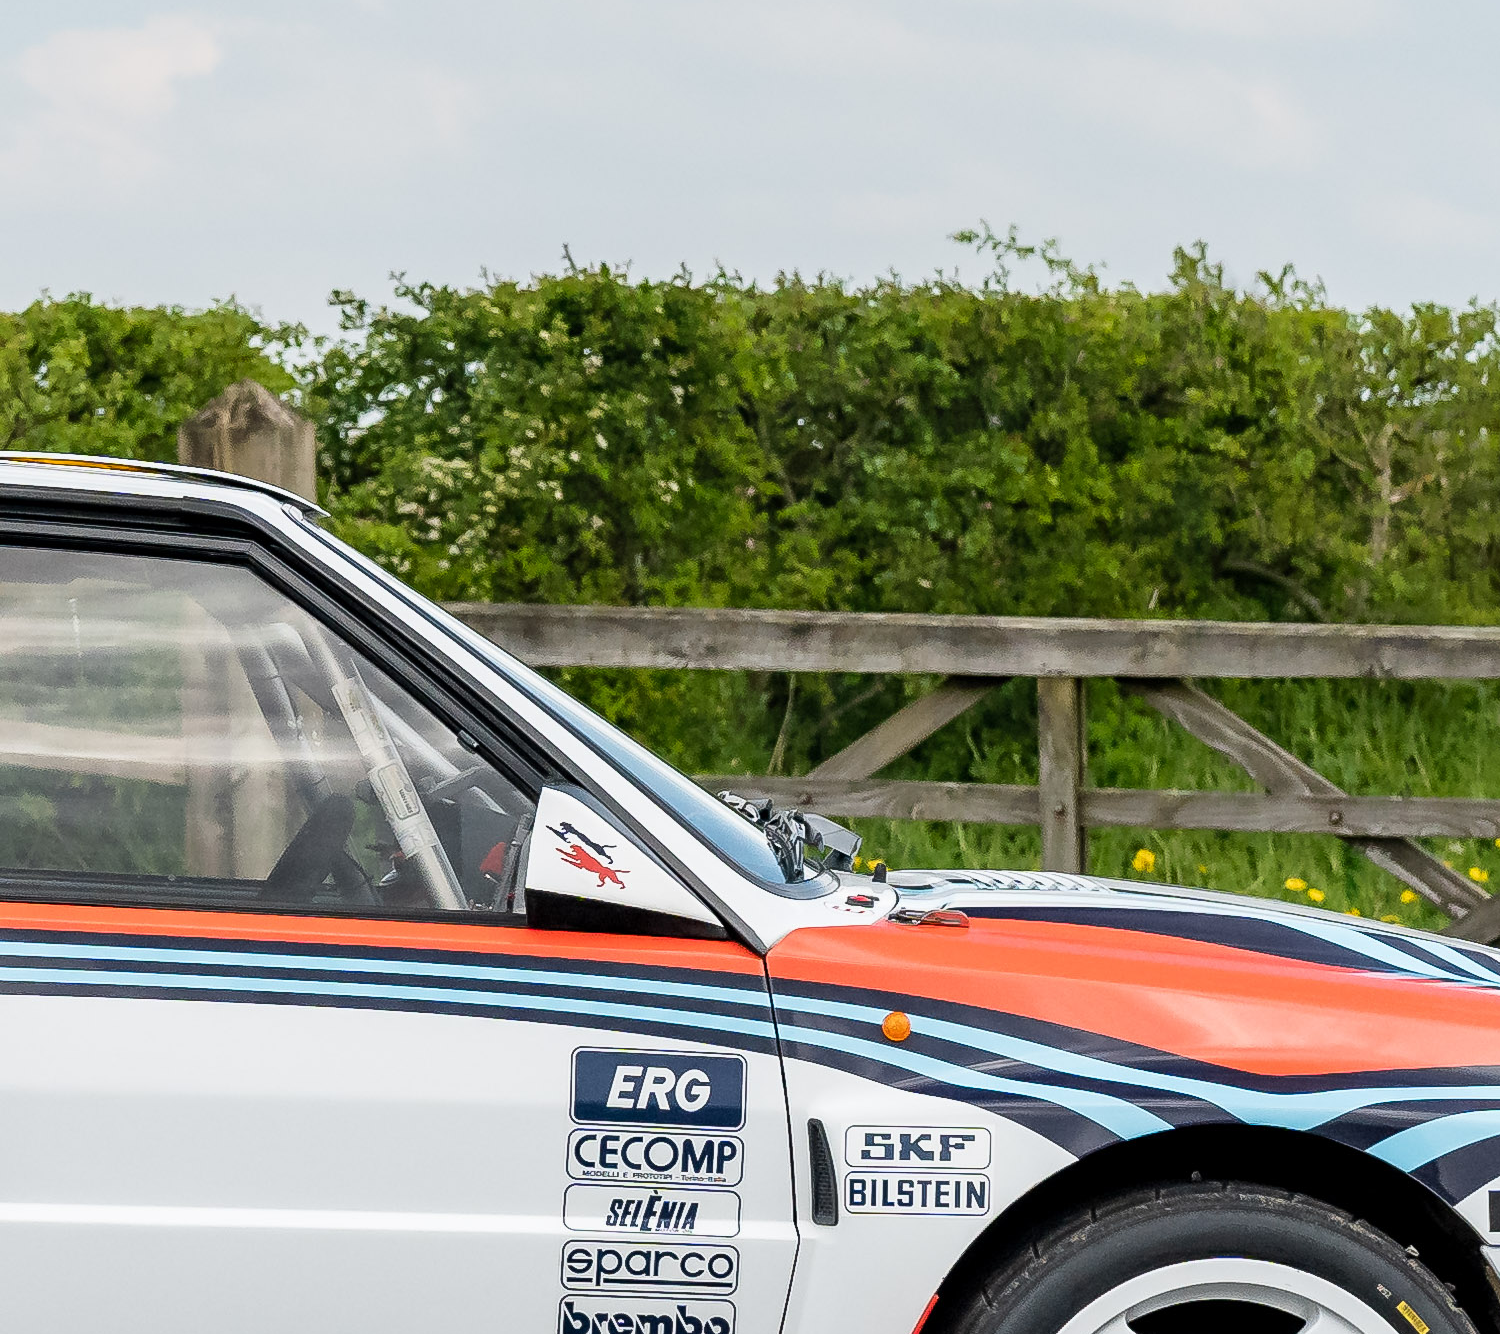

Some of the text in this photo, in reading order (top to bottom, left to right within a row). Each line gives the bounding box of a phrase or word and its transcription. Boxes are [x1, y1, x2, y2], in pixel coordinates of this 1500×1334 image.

[606, 1066, 711, 1112] ERG
[575, 1134, 738, 1174] CECOMP
[861, 1133, 976, 1162] SKF
[606, 1189, 698, 1231] SELÈNIA
[849, 1179, 986, 1208] BILSTEIN
[567, 1249, 733, 1286] sparco
